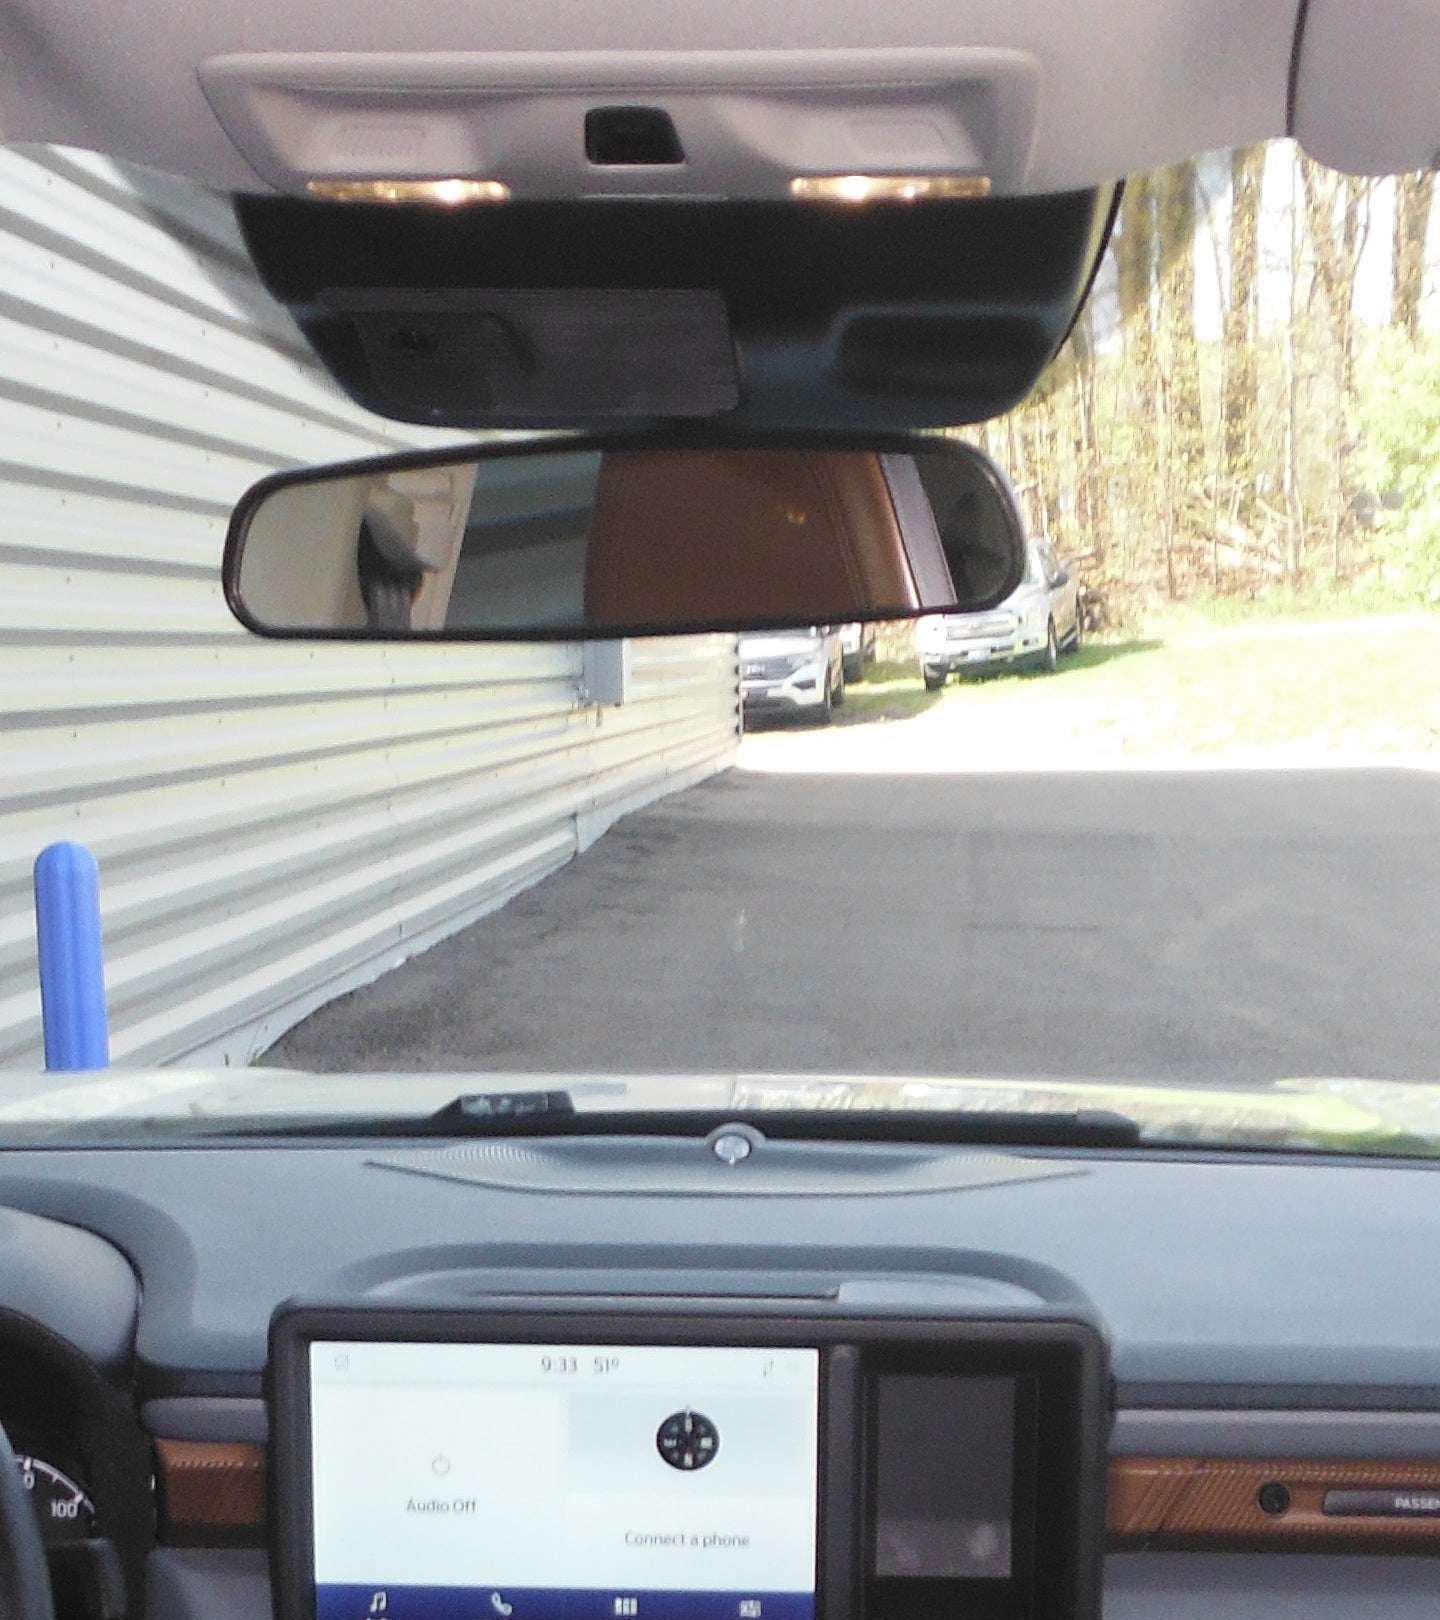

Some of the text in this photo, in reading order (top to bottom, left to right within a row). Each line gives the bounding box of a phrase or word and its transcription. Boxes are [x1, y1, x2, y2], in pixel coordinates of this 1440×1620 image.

[541, 1356, 577, 1373] 9:33
[50, 1500, 79, 1519] 100
[406, 1498, 477, 1513] Audio Off
[624, 1530, 751, 1548] Connect a phone
